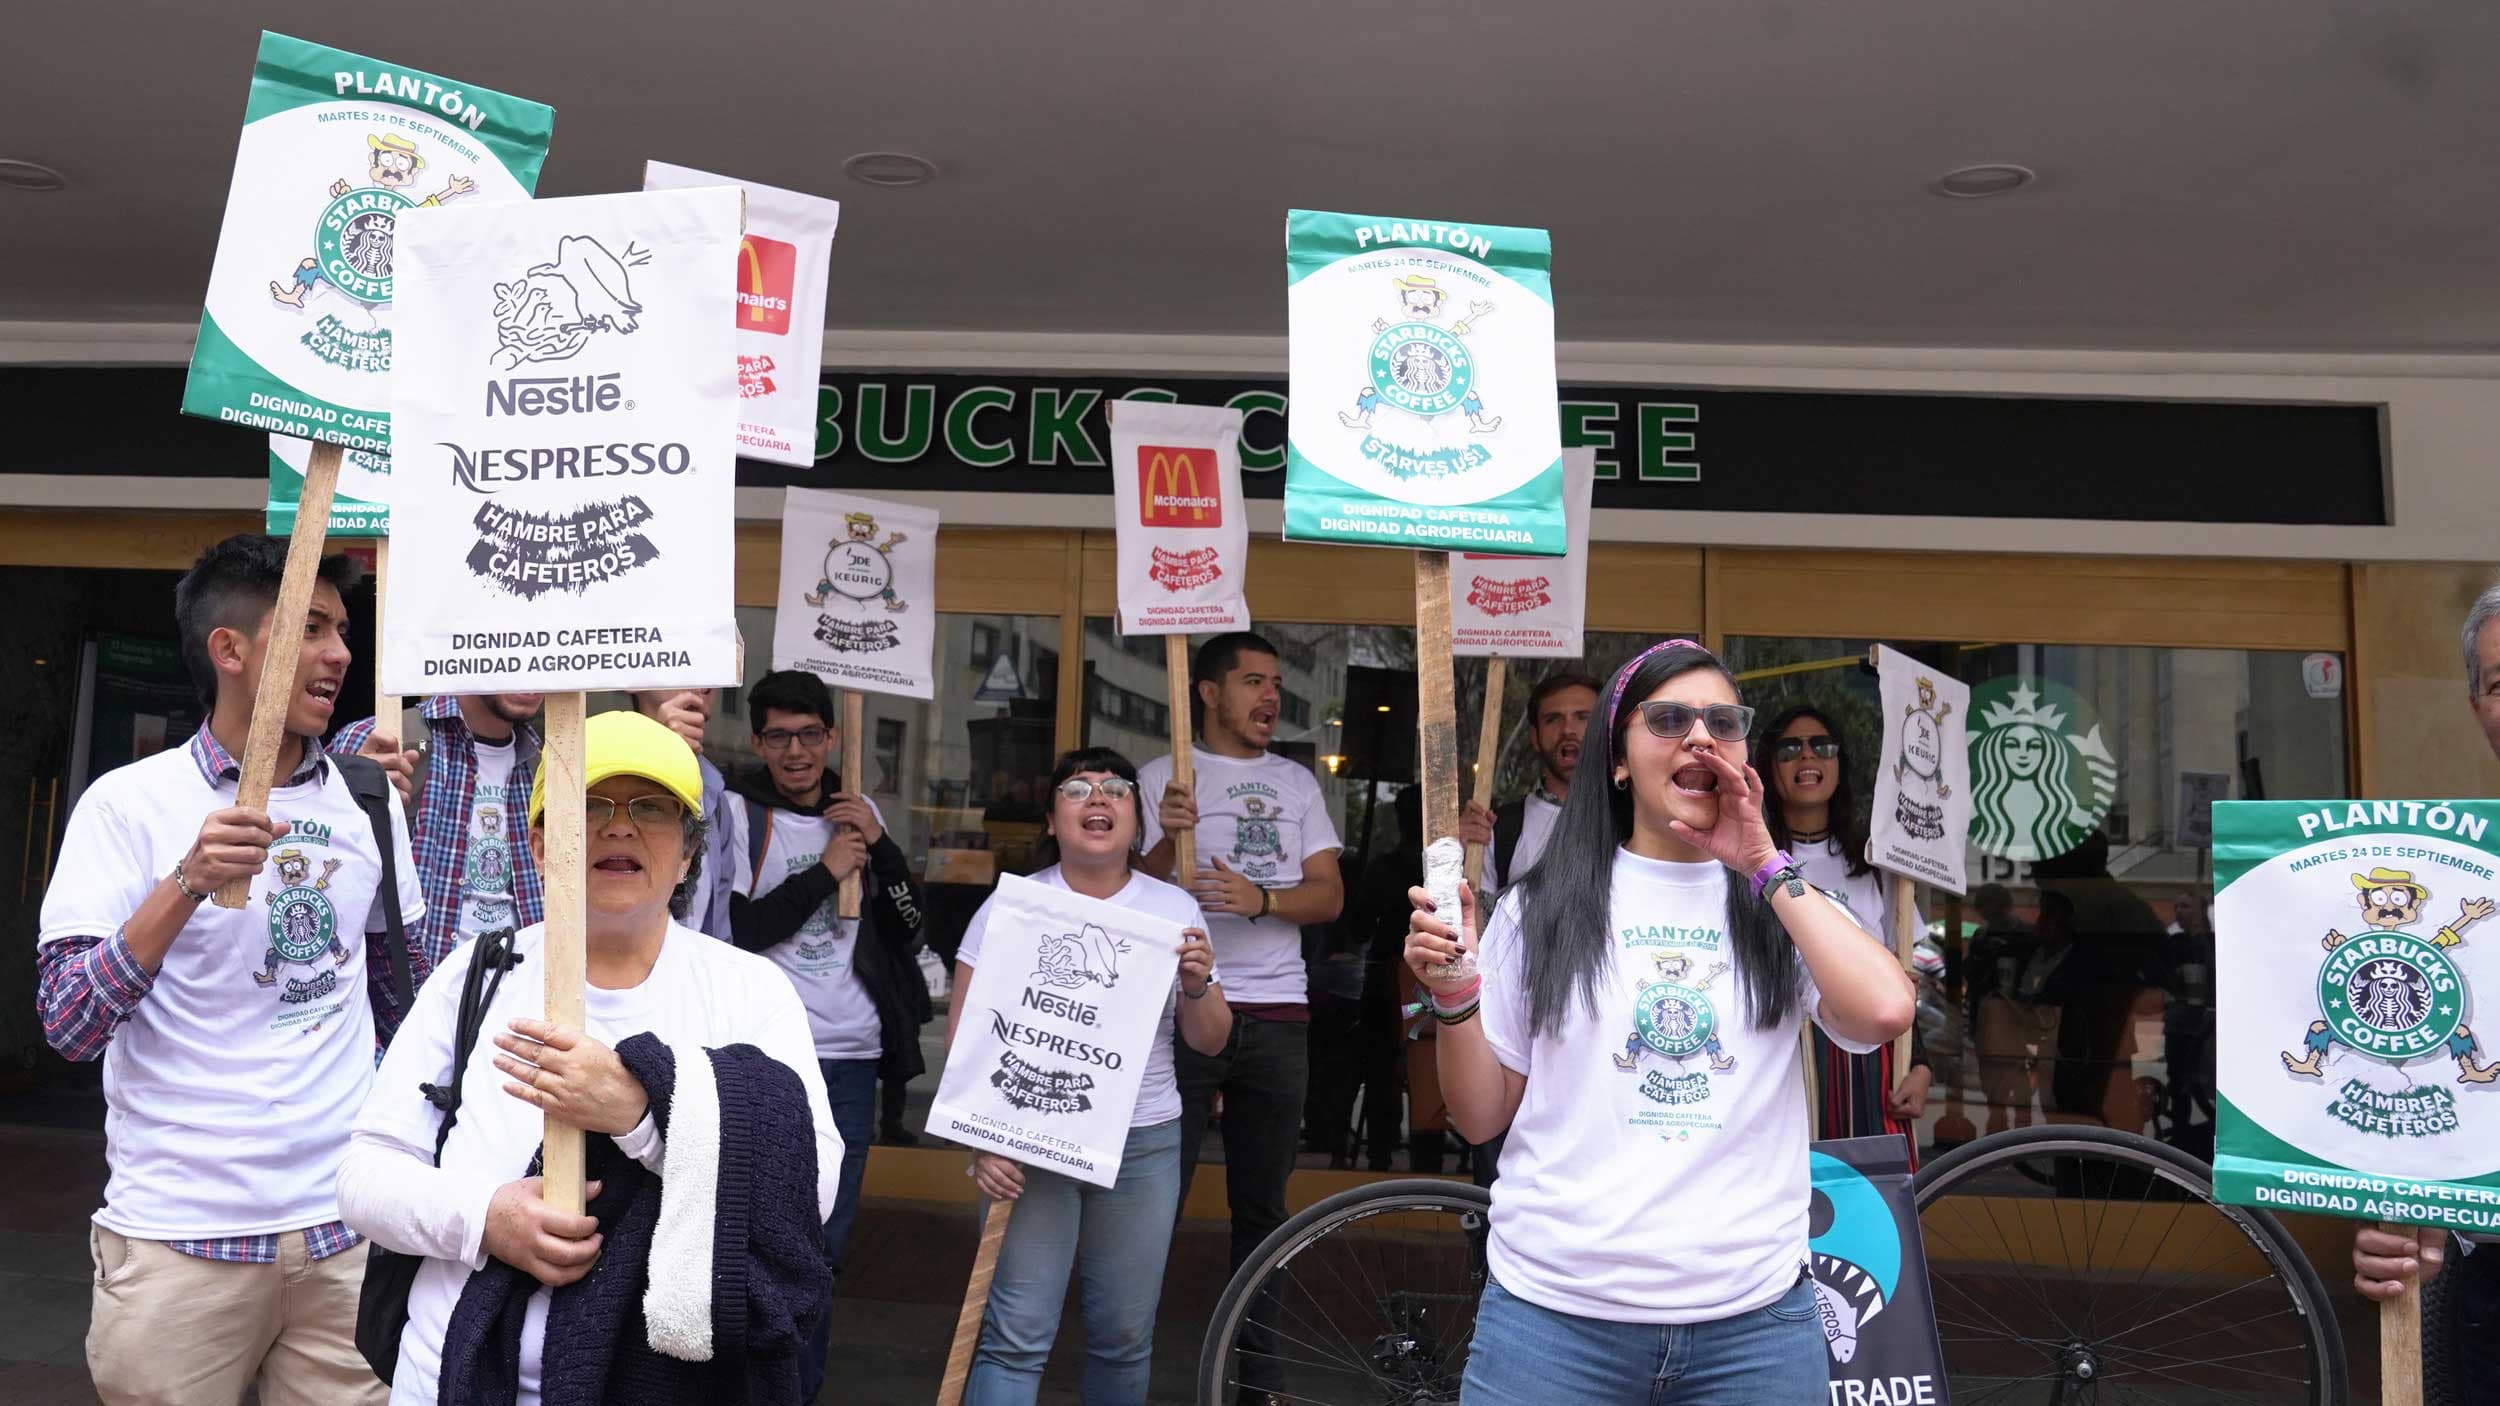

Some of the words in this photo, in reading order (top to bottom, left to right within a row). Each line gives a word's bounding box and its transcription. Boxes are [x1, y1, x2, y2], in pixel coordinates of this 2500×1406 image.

[334, 71, 487, 131] PLANTÓN
[318, 111, 369, 123] MARTES
[372, 113, 386, 123] 24
[389, 116, 406, 127] DE
[408, 121, 481, 165] SEPTIEMBRE
[1354, 222, 1492, 259] PLANTÓN
[329, 259, 392, 297] COFFE
[1348, 258, 1391, 274] MARTES
[1394, 258, 1406, 267] 24
[1409, 258, 1423, 268] DE
[1425, 259, 1493, 289] SEPTIEMBRE
[737, 291, 787, 311] nald's
[319, 315, 391, 351] HAMBRE
[309, 333, 391, 370] CAFETERO
[1374, 325, 1468, 369] STARBUCKS
[250, 392, 337, 423] DIGNIDAD
[486, 372, 621, 417] Nestlé
[1385, 384, 1457, 411] COFFEE
[220, 406, 309, 437] DIGNIDAD
[736, 434, 792, 452] PECUARIA
[1364, 438, 1450, 474] STARVES
[1454, 448, 1484, 472] US!
[433, 442, 690, 494] NESPRESSO
[331, 504, 387, 513] GNIDAD
[1154, 494, 1217, 508] McDonald's
[482, 506, 578, 543] HAMBRE
[583, 502, 643, 536] PARA
[1343, 503, 1423, 520] DIGNIDAD
[1426, 508, 1510, 526] CAFETERA
[1320, 518, 1401, 535] DIGNIDAD
[1404, 523, 1534, 544] AGROPECUARIA
[489, 545, 636, 583] CAFETEROS
[848, 554, 871, 567] JDE
[1189, 550, 1216, 567] PARA
[834, 572, 882, 586] KEURIG
[1156, 568, 1214, 586] CAFETEROS
[1518, 579, 1546, 595] PARA
[1147, 606, 1185, 615] DIGNIDAD
[1475, 595, 1542, 611] CAFETEROS
[821, 614, 865, 635] HAMBRE
[866, 621, 894, 635] PARA
[1139, 617, 1176, 626] DIGNIDAD
[1178, 615, 1235, 625] AGROPECUARIA
[1457, 628, 1502, 637] DIGNIDAD
[1504, 629, 1551, 638] CAFETERA
[452, 629, 550, 650] DIGNIDAD
[556, 627, 663, 646] CAFETERA
[823, 633, 891, 651] CAFETEROS
[1453, 638, 1488, 647] GNIDAD
[1490, 638, 1564, 649] AGROPECUARIA
[424, 655, 521, 676] DIGNIDAD
[527, 650, 692, 673] AGROPECUARIA
[793, 661, 839, 675] DIGNIDAD
[841, 669, 914, 687] AGROPECUARIA
[1908, 744, 1936, 765] KEURIG
[2297, 800, 2489, 843] PLANTÓN
[470, 838, 511, 863] STARBUCKS
[2290, 849, 2348, 874] MARTES
[2352, 847, 2367, 859] 24
[2372, 846, 2392, 857] DE
[2396, 846, 2495, 881] SEPTIEMBRE
[271, 891, 330, 925] STARBUCKS
[281, 936, 326, 957] COFFEE
[1622, 926, 1722, 943] PLANTÓN
[2326, 937, 2455, 993] STARBUCKS
[1021, 986, 1098, 1027] Nestlé
[1638, 985, 1709, 1015] STARBUCKS
[987, 1008, 1122, 1071] NESPRESSO
[1646, 1030, 1702, 1052] COFFEE
[2341, 1018, 2440, 1052] COFFEE
[1004, 1053, 1053, 1089] HAMBRE
[1055, 1073, 1091, 1090] PARA
[1000, 1077, 1081, 1112] CAFETEROS
[1644, 1086, 1710, 1104] CAFETEROS
[1629, 1118, 1664, 1127] DIGNIDAD
[1665, 1120, 1722, 1130] AGROPECUARIA
[1639, 1110, 1674, 1119] DIGNIDAD
[1675, 1112, 1712, 1121] CAFETERA
[2337, 1103, 2456, 1134] CAFETEROS
[951, 1119, 1005, 1145] DIGNIDAD
[1007, 1136, 1094, 1172] AGROPECUARIA
[970, 1113, 1024, 1138] DIGNIDAD
[1026, 1129, 1083, 1155] CAFETERA
[2283, 1169, 2387, 1193] DIGNIDAD
[2256, 1186, 2358, 1212] DIGNIDAD
[1828, 1374, 1936, 1406] TRADE
